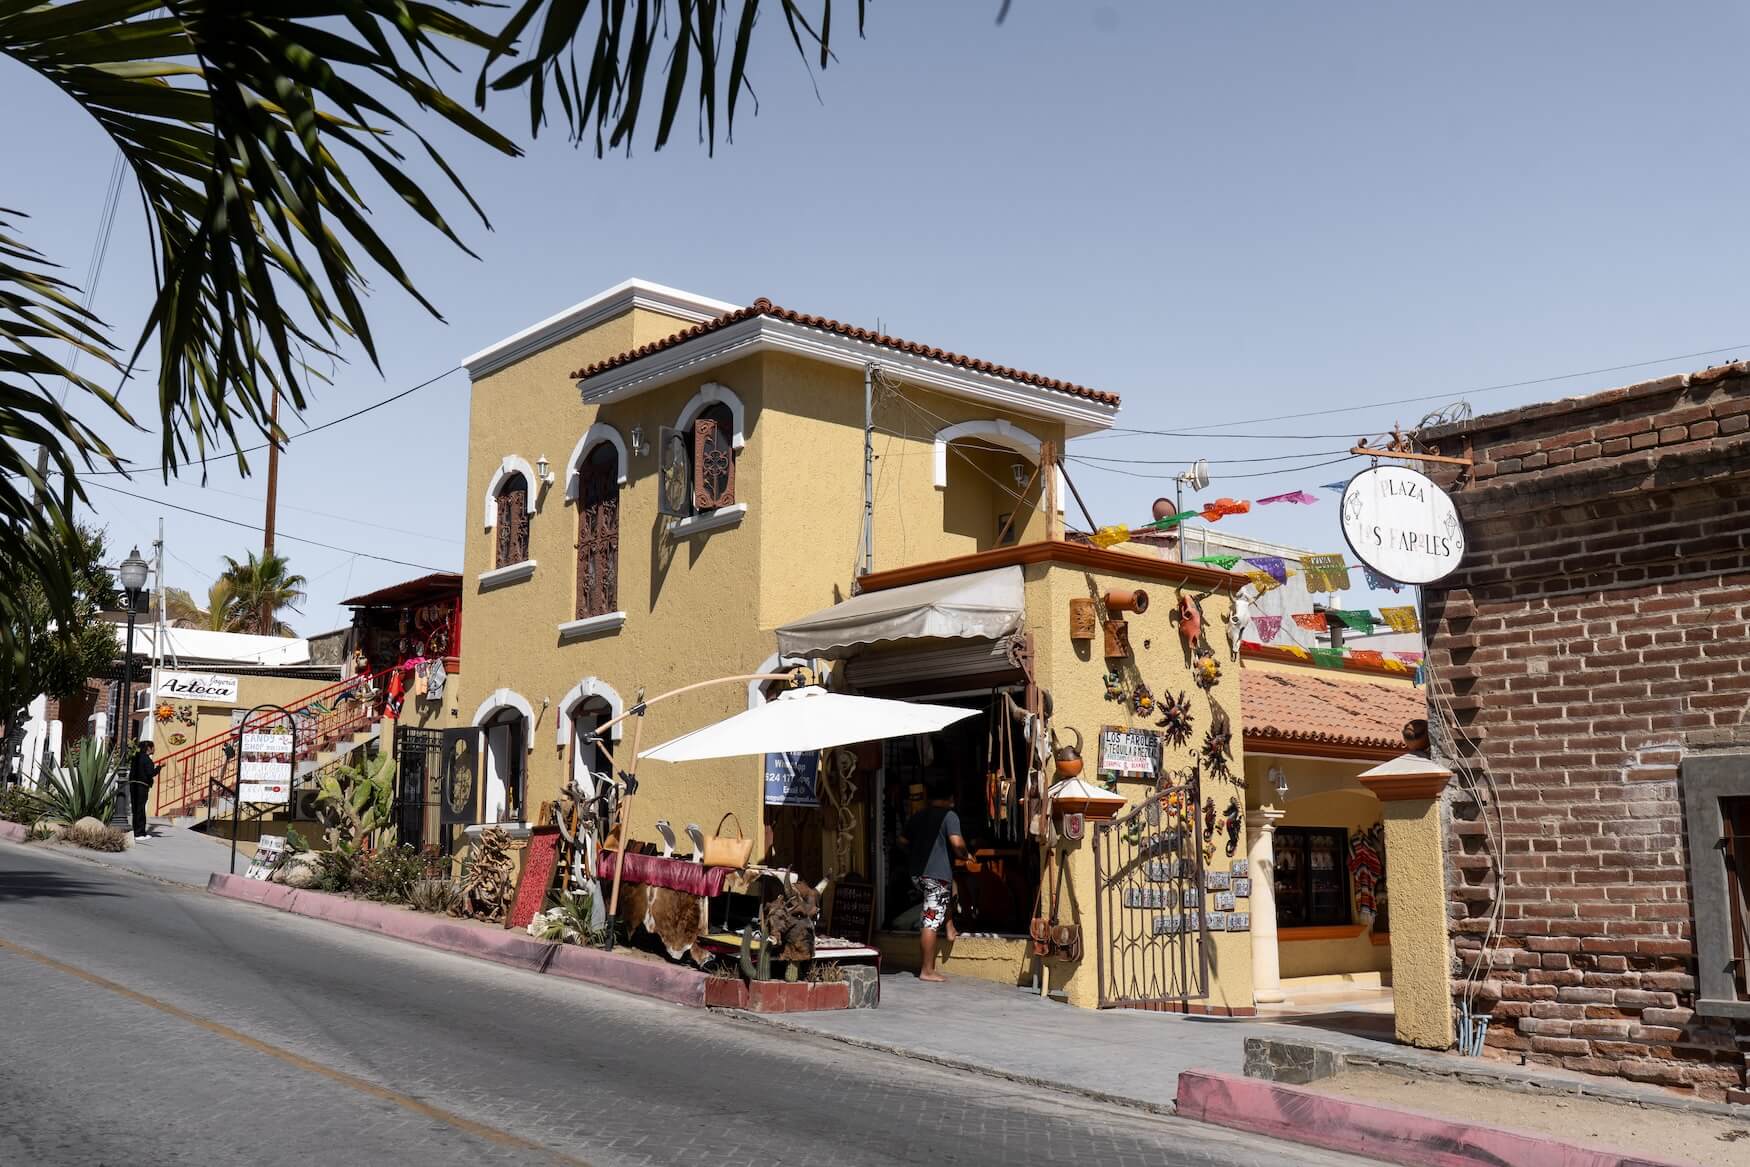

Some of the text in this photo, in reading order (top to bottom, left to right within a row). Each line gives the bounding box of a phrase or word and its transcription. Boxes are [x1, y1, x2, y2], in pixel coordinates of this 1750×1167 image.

[1380, 479, 1424, 503] PLAZA
[160, 679, 234, 696] Azteca
[244, 734, 275, 743] CANDY
[1105, 731, 1158, 747] LOS FAROLES
